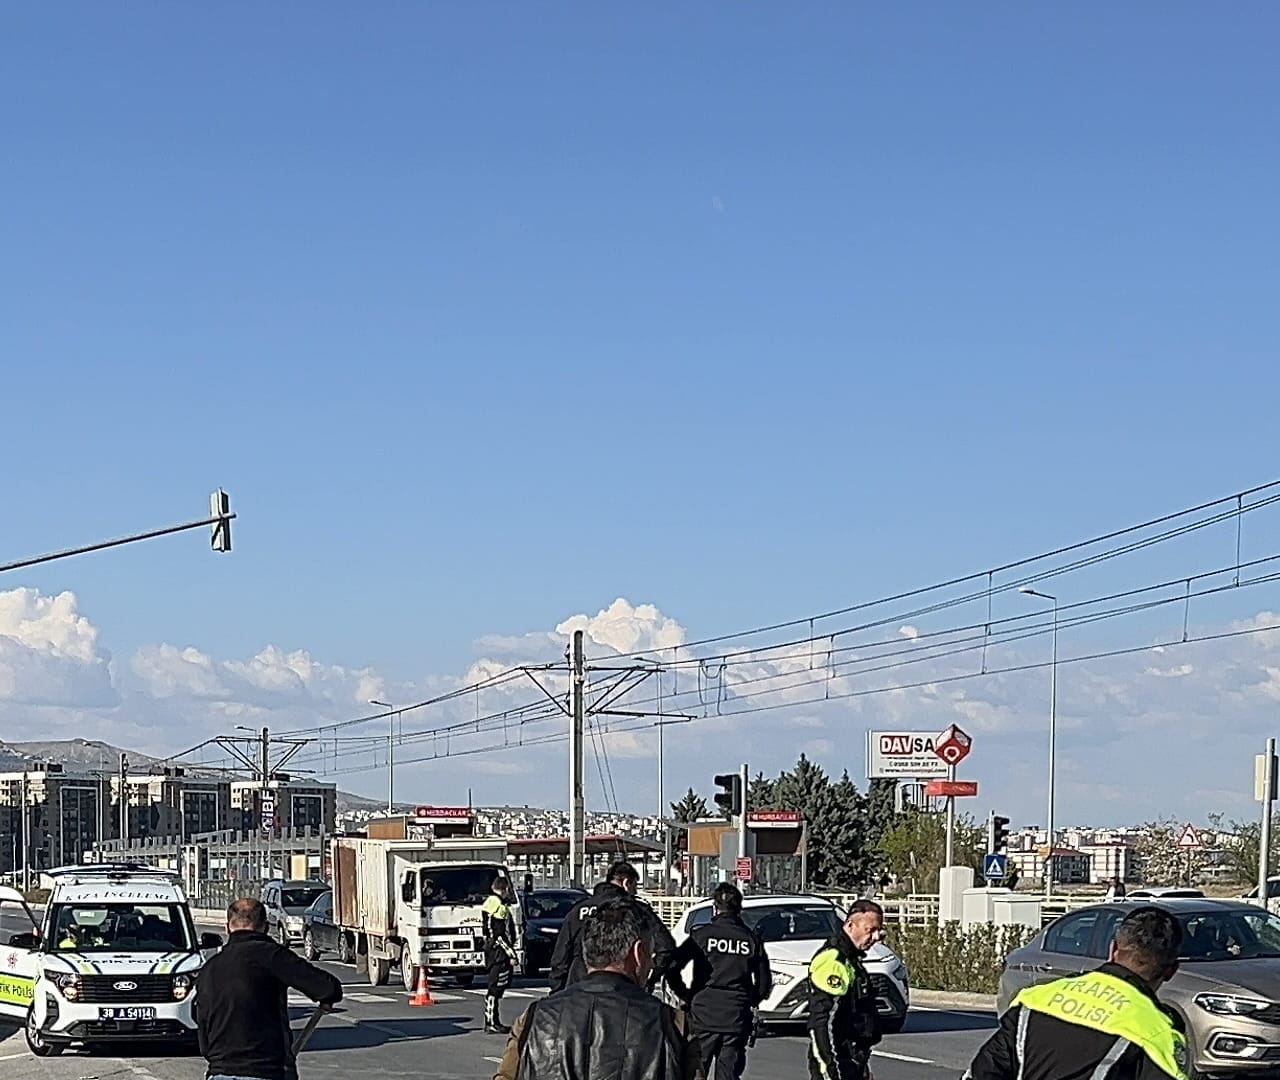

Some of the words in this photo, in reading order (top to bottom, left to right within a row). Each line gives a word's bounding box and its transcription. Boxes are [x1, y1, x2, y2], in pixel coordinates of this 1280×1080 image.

[880, 735, 934, 754] DAVSA
[707, 938, 750, 955] POLİS
[1062, 980, 1132, 1012] TRAFİK
[1047, 991, 1115, 1027] POLİSİ
